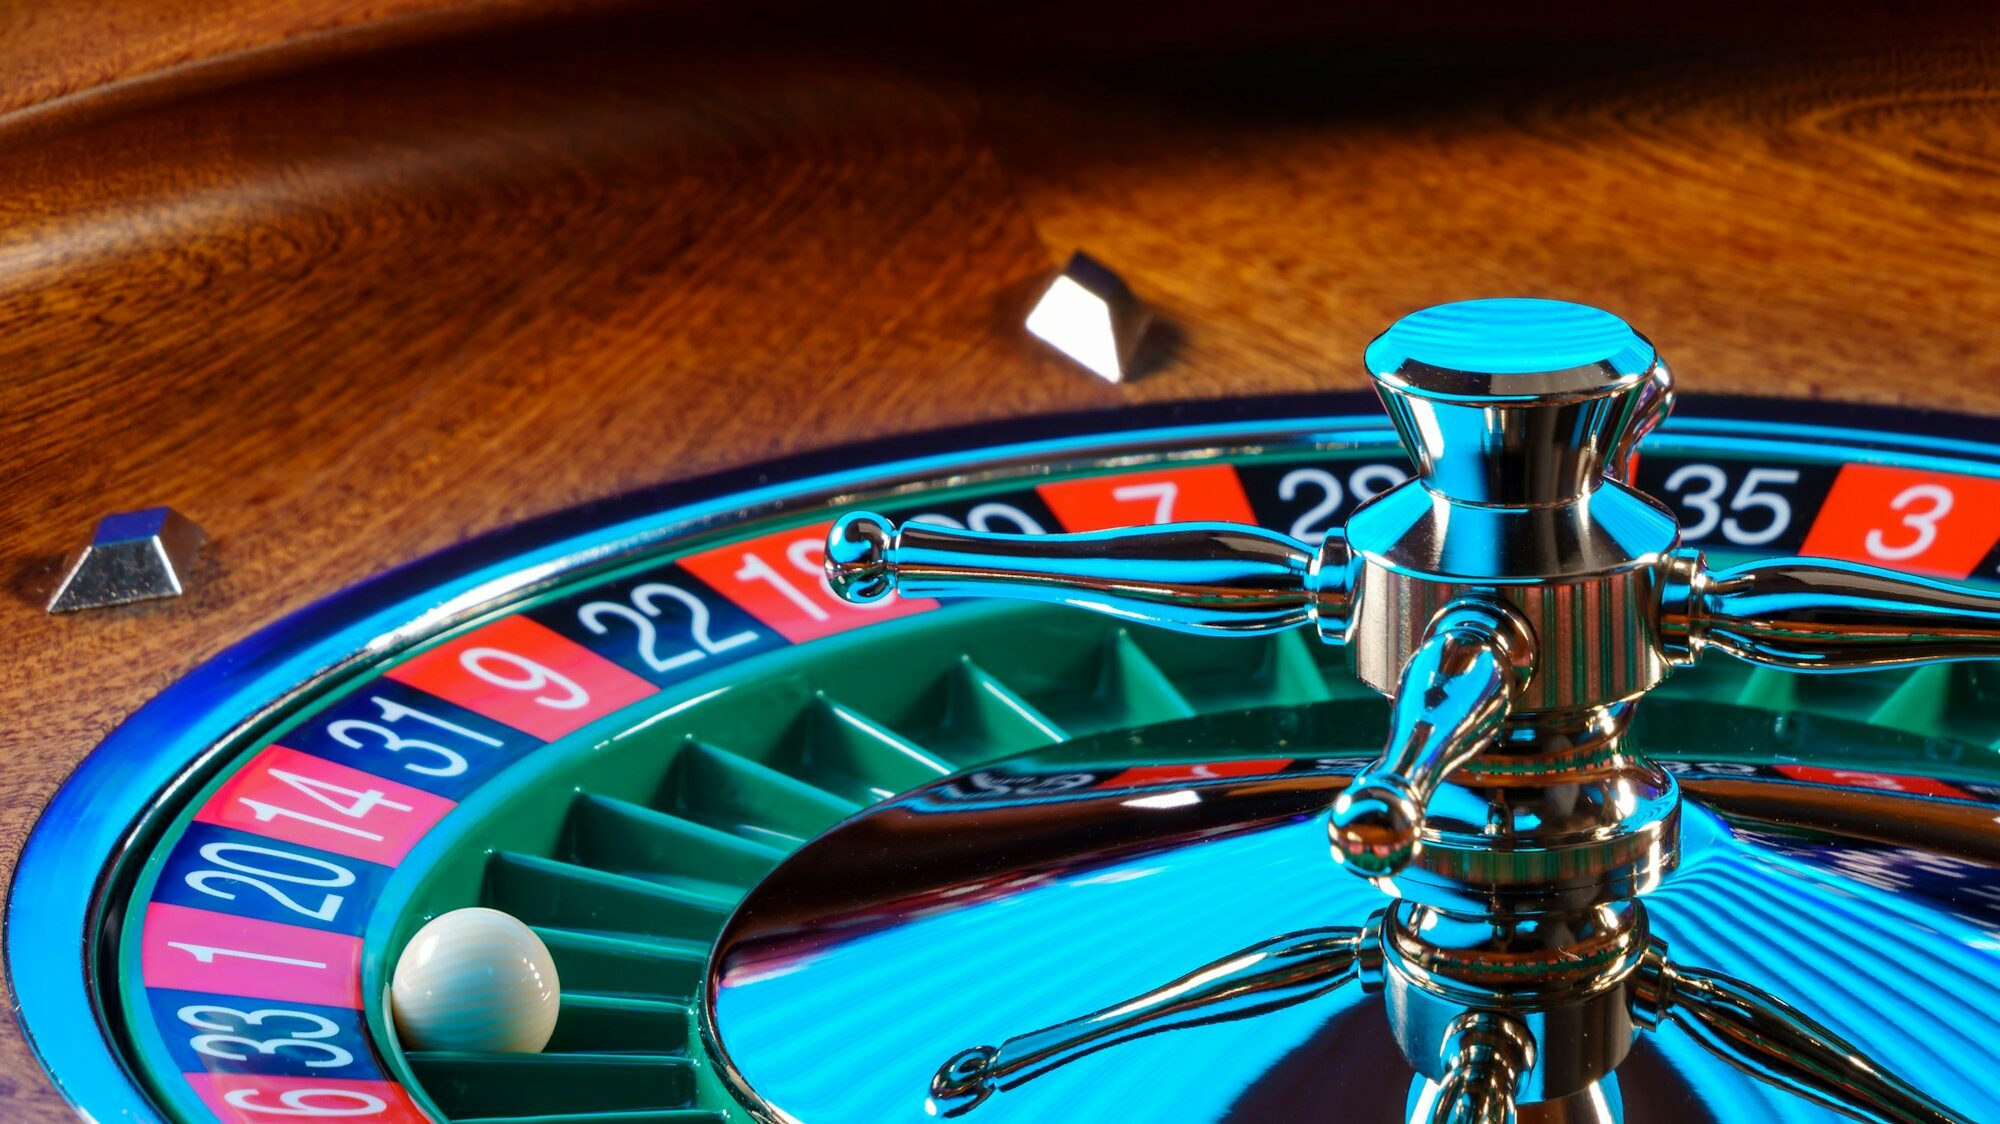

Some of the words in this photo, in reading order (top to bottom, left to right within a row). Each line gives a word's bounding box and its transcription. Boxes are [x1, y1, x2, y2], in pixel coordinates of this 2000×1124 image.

[1664, 463, 1800, 546] 35
[1864, 484, 1954, 560] 3
[578, 582, 759, 674] 22
[459, 647, 591, 709] 9
[326, 696, 505, 777] 31
[238, 768, 413, 842] 14
[185, 842, 356, 922] 20
[167, 941, 327, 969] 1
[177, 1004, 354, 1068] 33
[223, 1088, 387, 1117] 6
